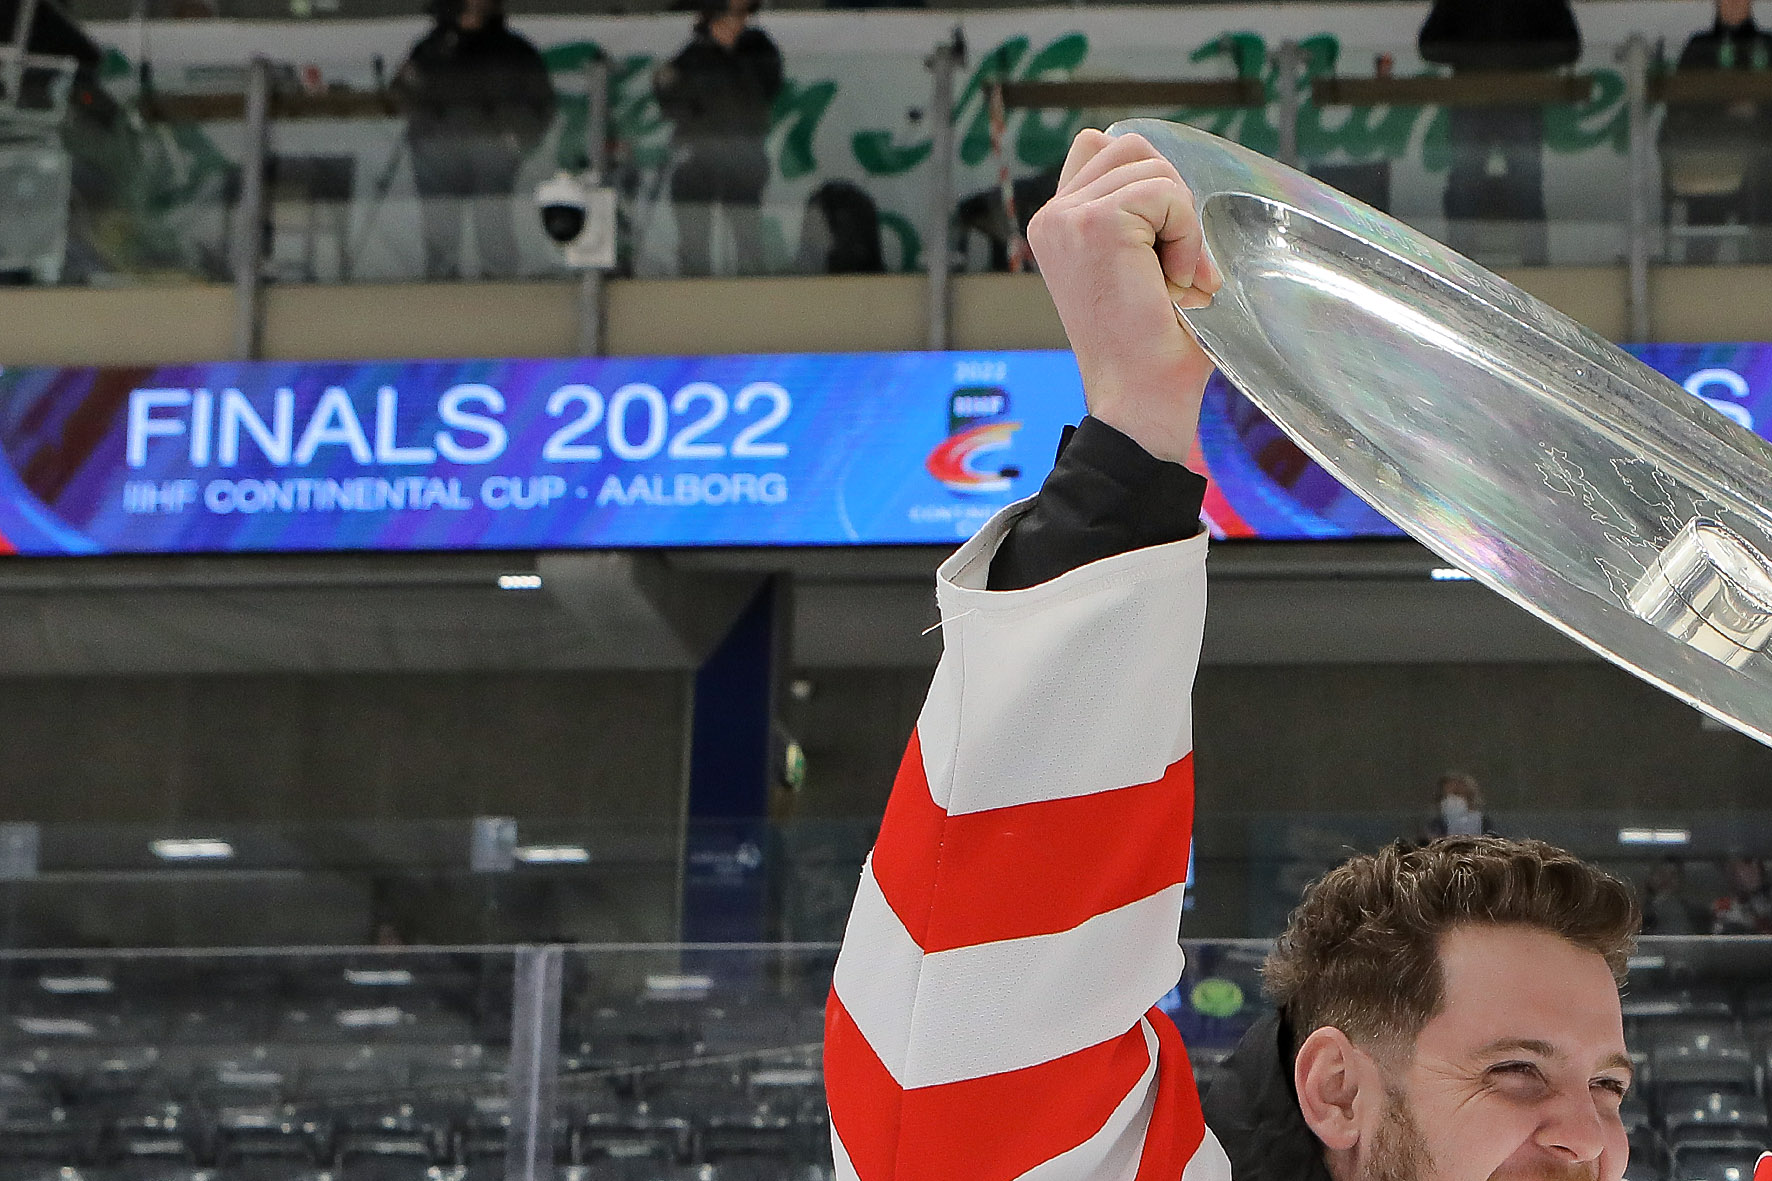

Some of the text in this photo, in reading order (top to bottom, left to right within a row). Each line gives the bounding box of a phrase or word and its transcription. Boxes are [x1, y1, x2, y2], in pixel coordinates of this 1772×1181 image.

[126, 381, 792, 468] FINALS 2022
[123, 472, 789, 514] IIHF CONTINENTAL CUP AALBORG
